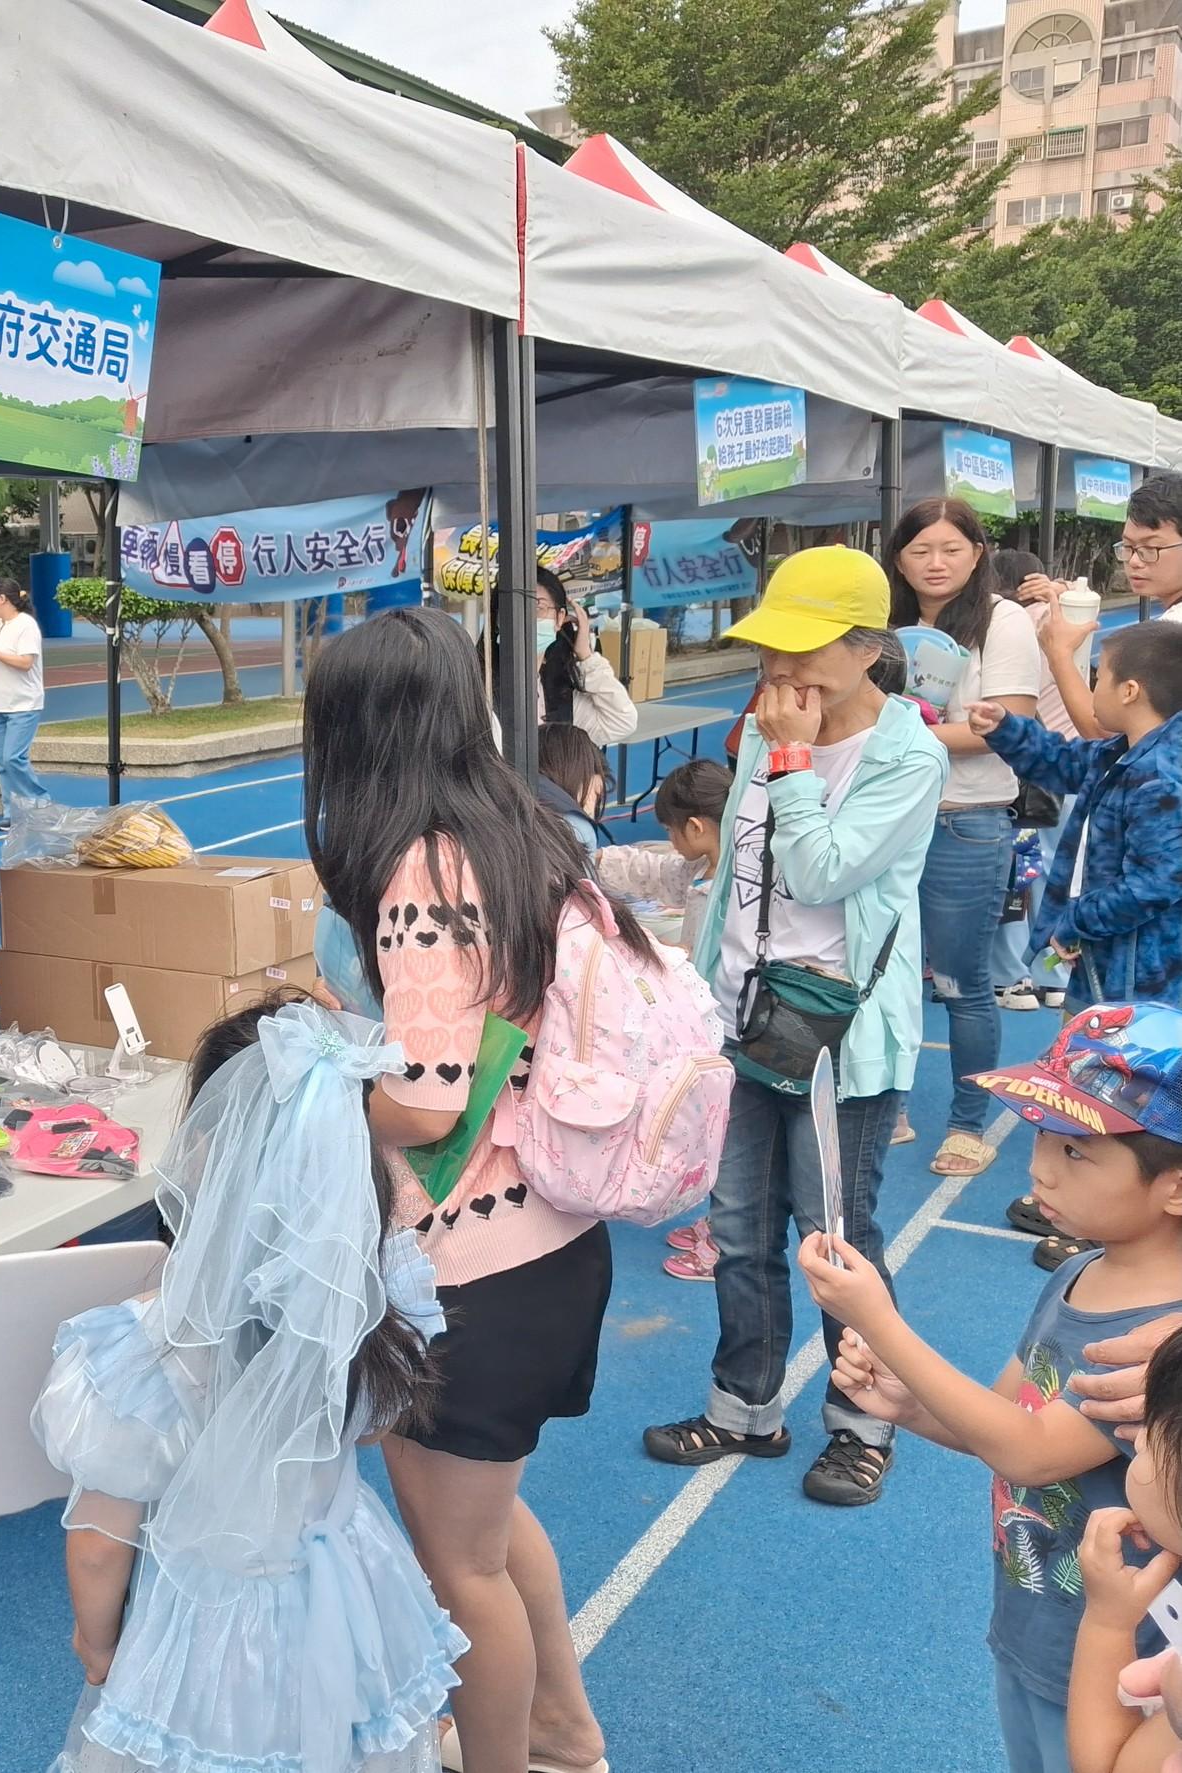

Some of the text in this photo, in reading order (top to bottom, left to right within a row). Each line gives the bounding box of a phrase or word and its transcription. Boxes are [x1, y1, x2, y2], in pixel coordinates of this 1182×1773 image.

[715, 404, 793, 439] 6次兒童發展篩檢
[717, 434, 793, 467] 給孩子最好的起跑點
[251, 525, 386, 576] 行人安全行
[642, 547, 745, 588] 行人安全行
[1028, 1075, 1062, 1092] MARVEL
